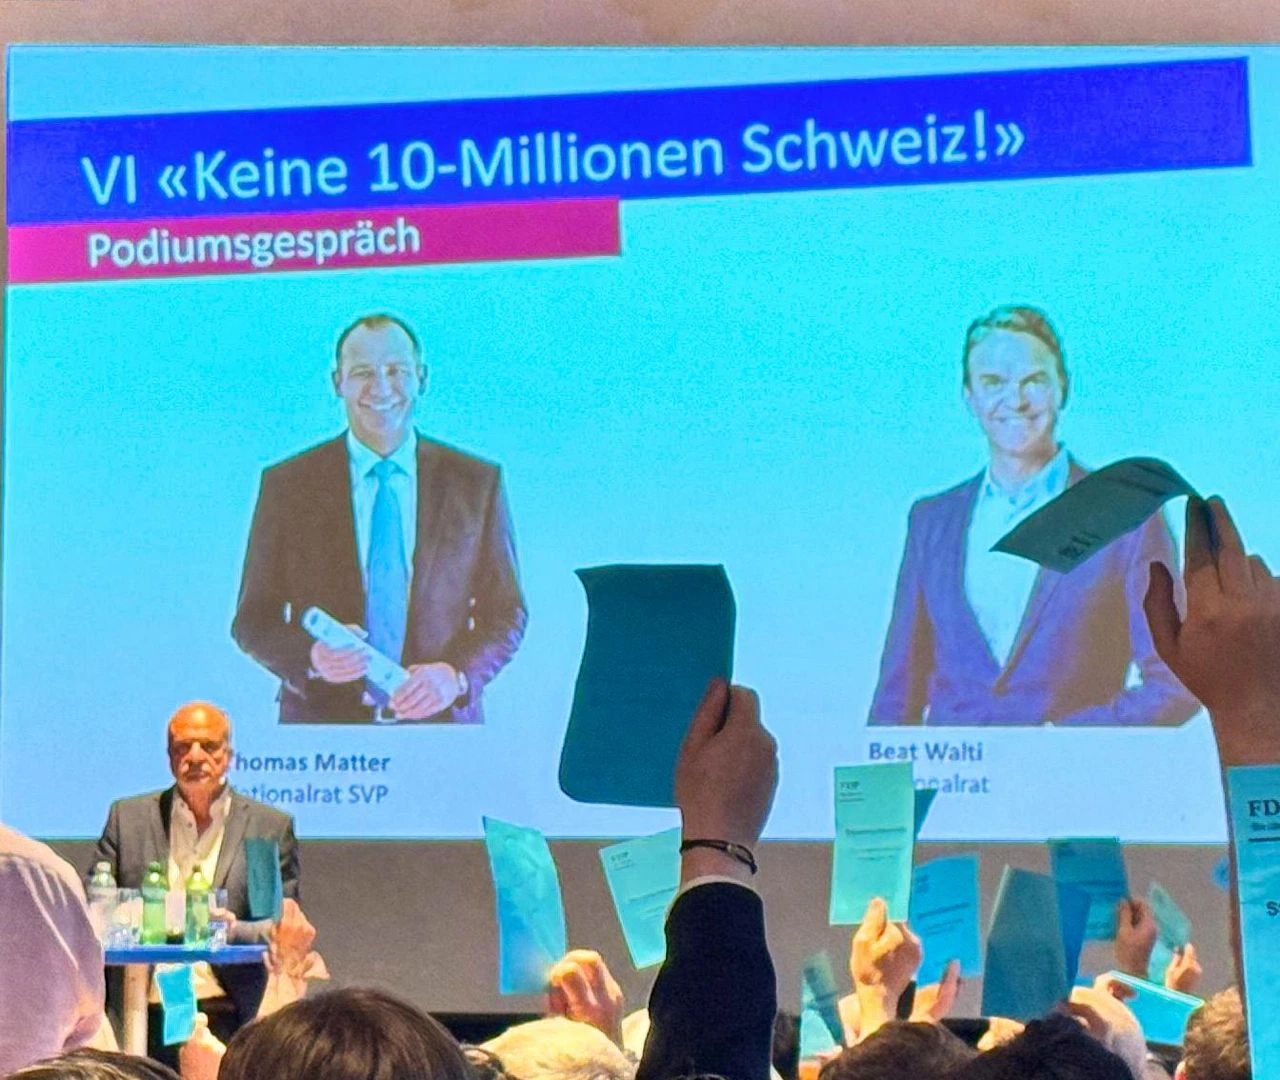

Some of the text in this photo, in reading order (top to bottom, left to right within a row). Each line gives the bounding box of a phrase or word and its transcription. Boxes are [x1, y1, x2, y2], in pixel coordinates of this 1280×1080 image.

[81, 109, 1025, 205] VI «Keine 10-Millionen Schweiz!»
[89, 217, 420, 269] Podiumsgespräch
[869, 742, 984, 761] Beat Walti
[235, 752, 391, 772] homas Matter
[348, 784, 390, 804] SVP
